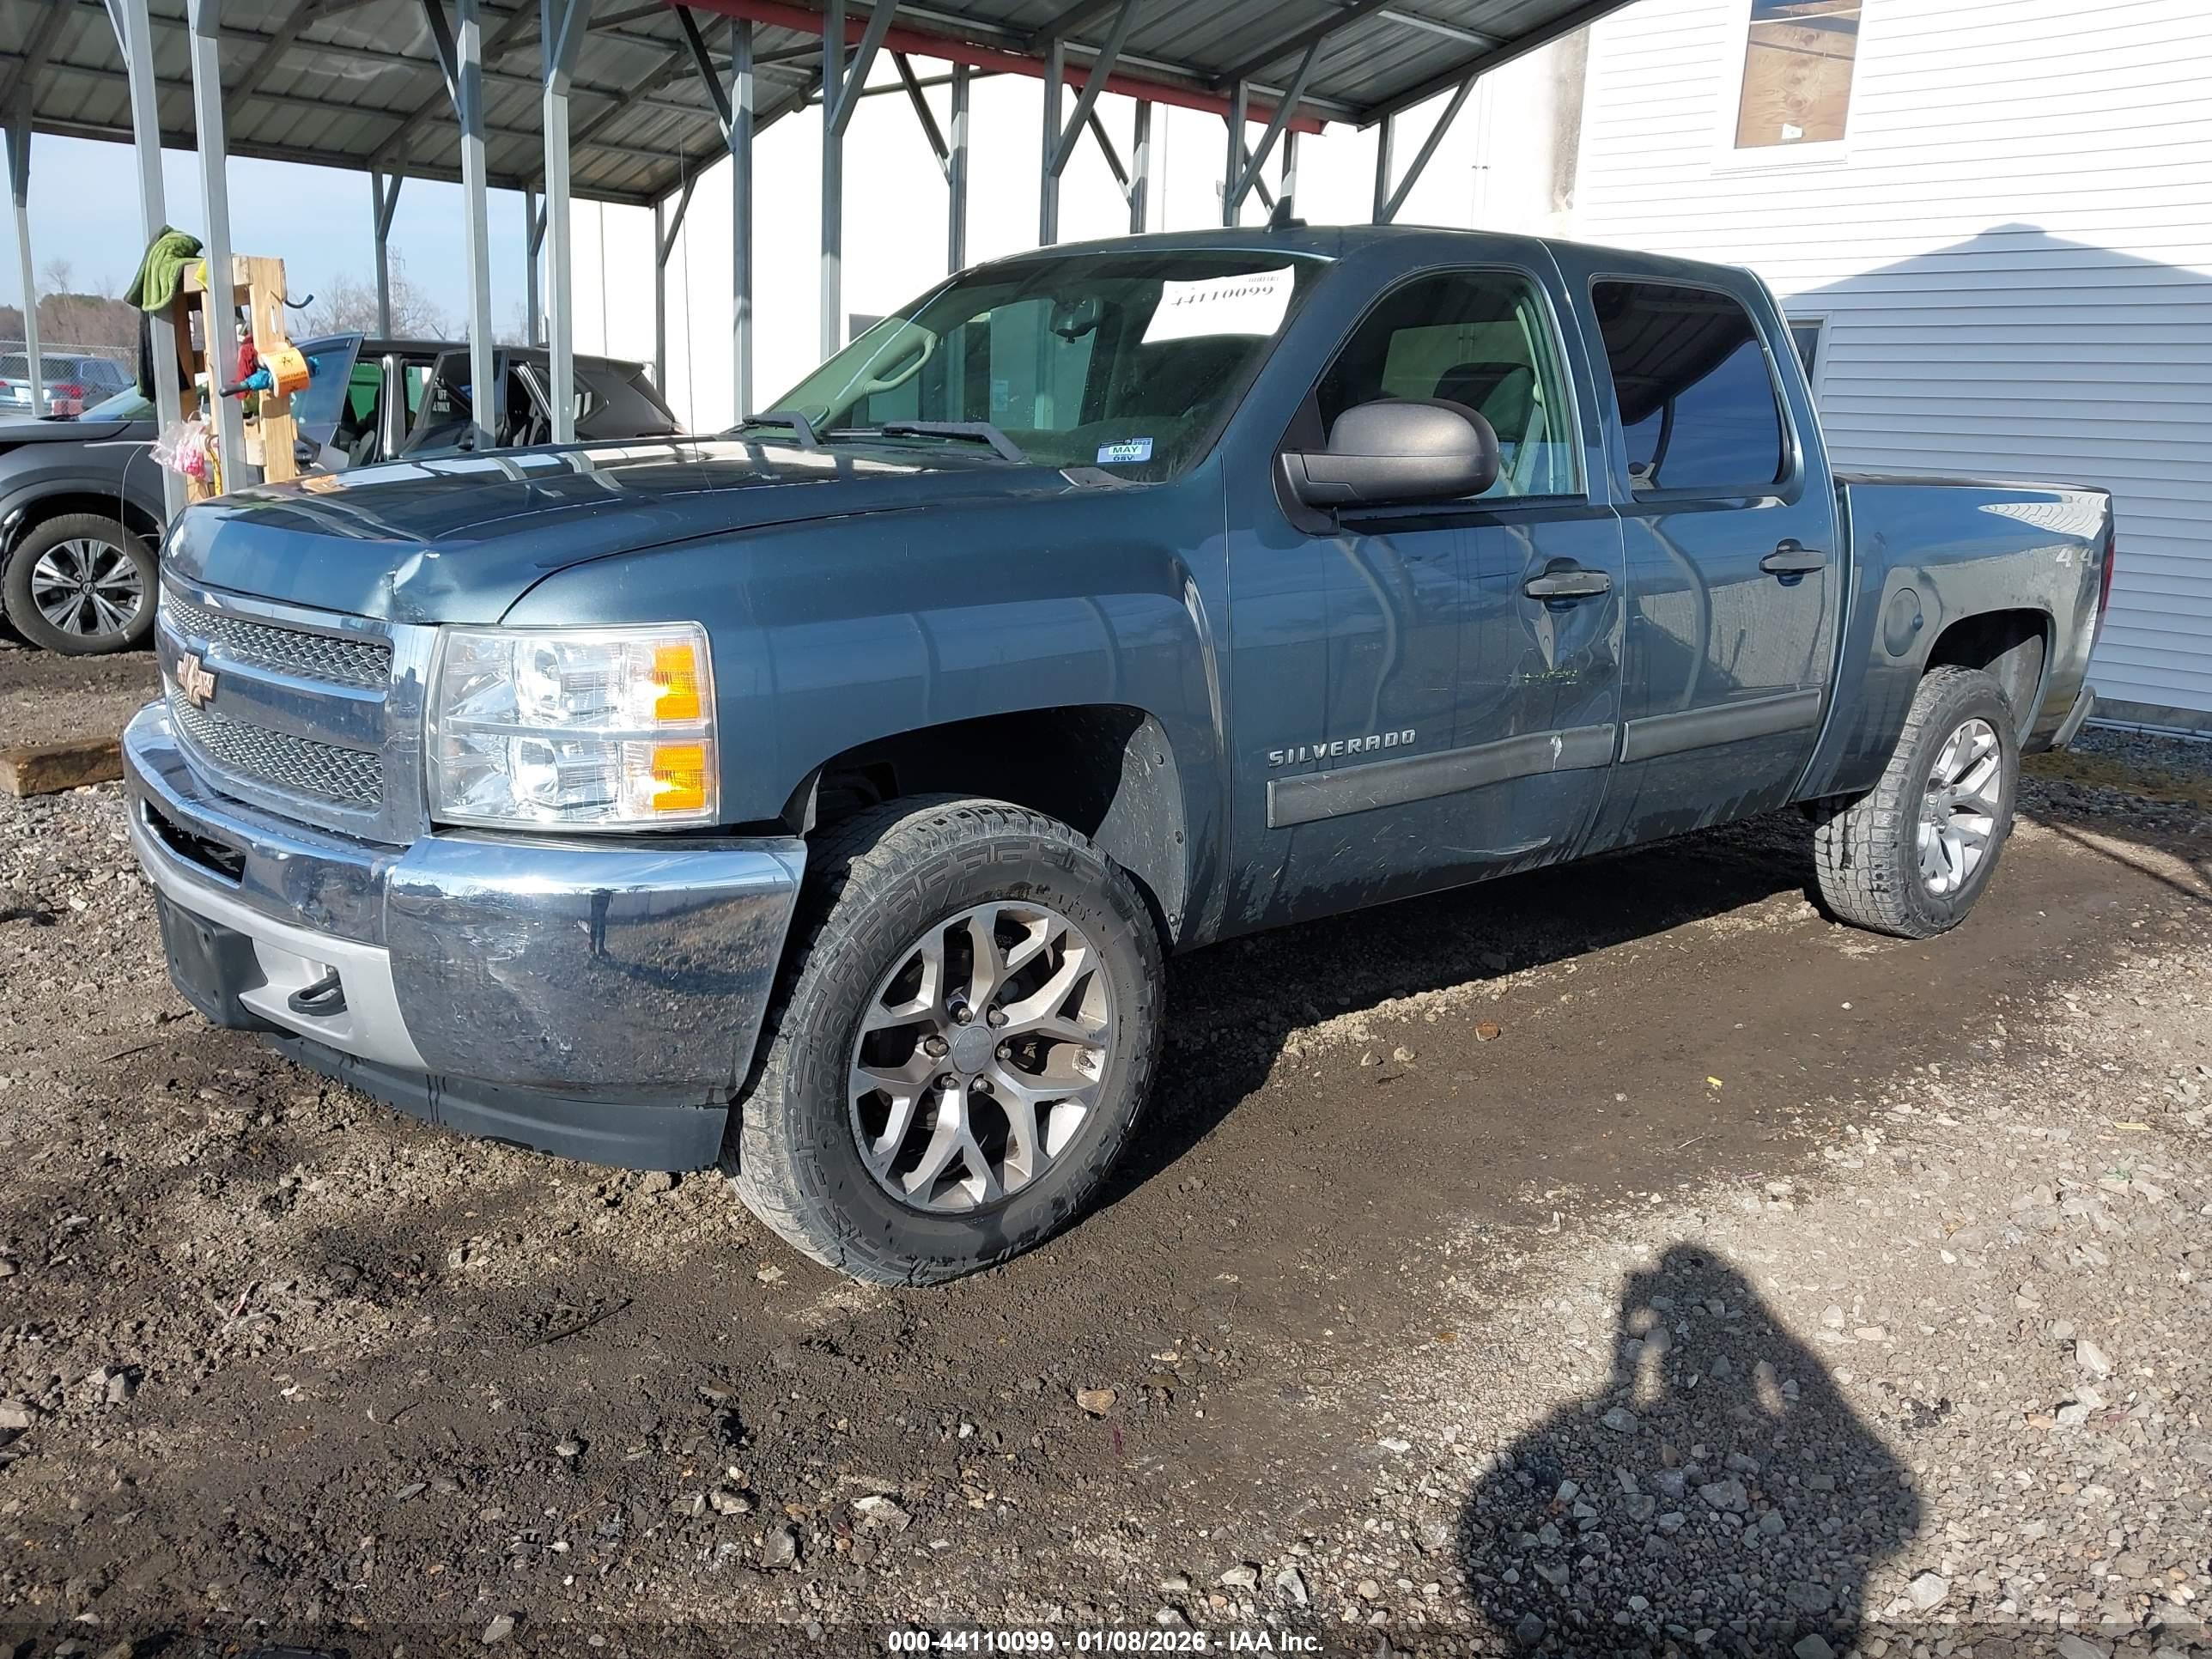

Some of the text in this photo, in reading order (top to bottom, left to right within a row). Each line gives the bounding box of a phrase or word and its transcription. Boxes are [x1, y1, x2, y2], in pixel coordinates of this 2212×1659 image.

[1112, 446, 1139, 454] MAY
[1268, 728, 1416, 768] SILVERADO
[817, 919, 911, 1150] CROSSWIND
